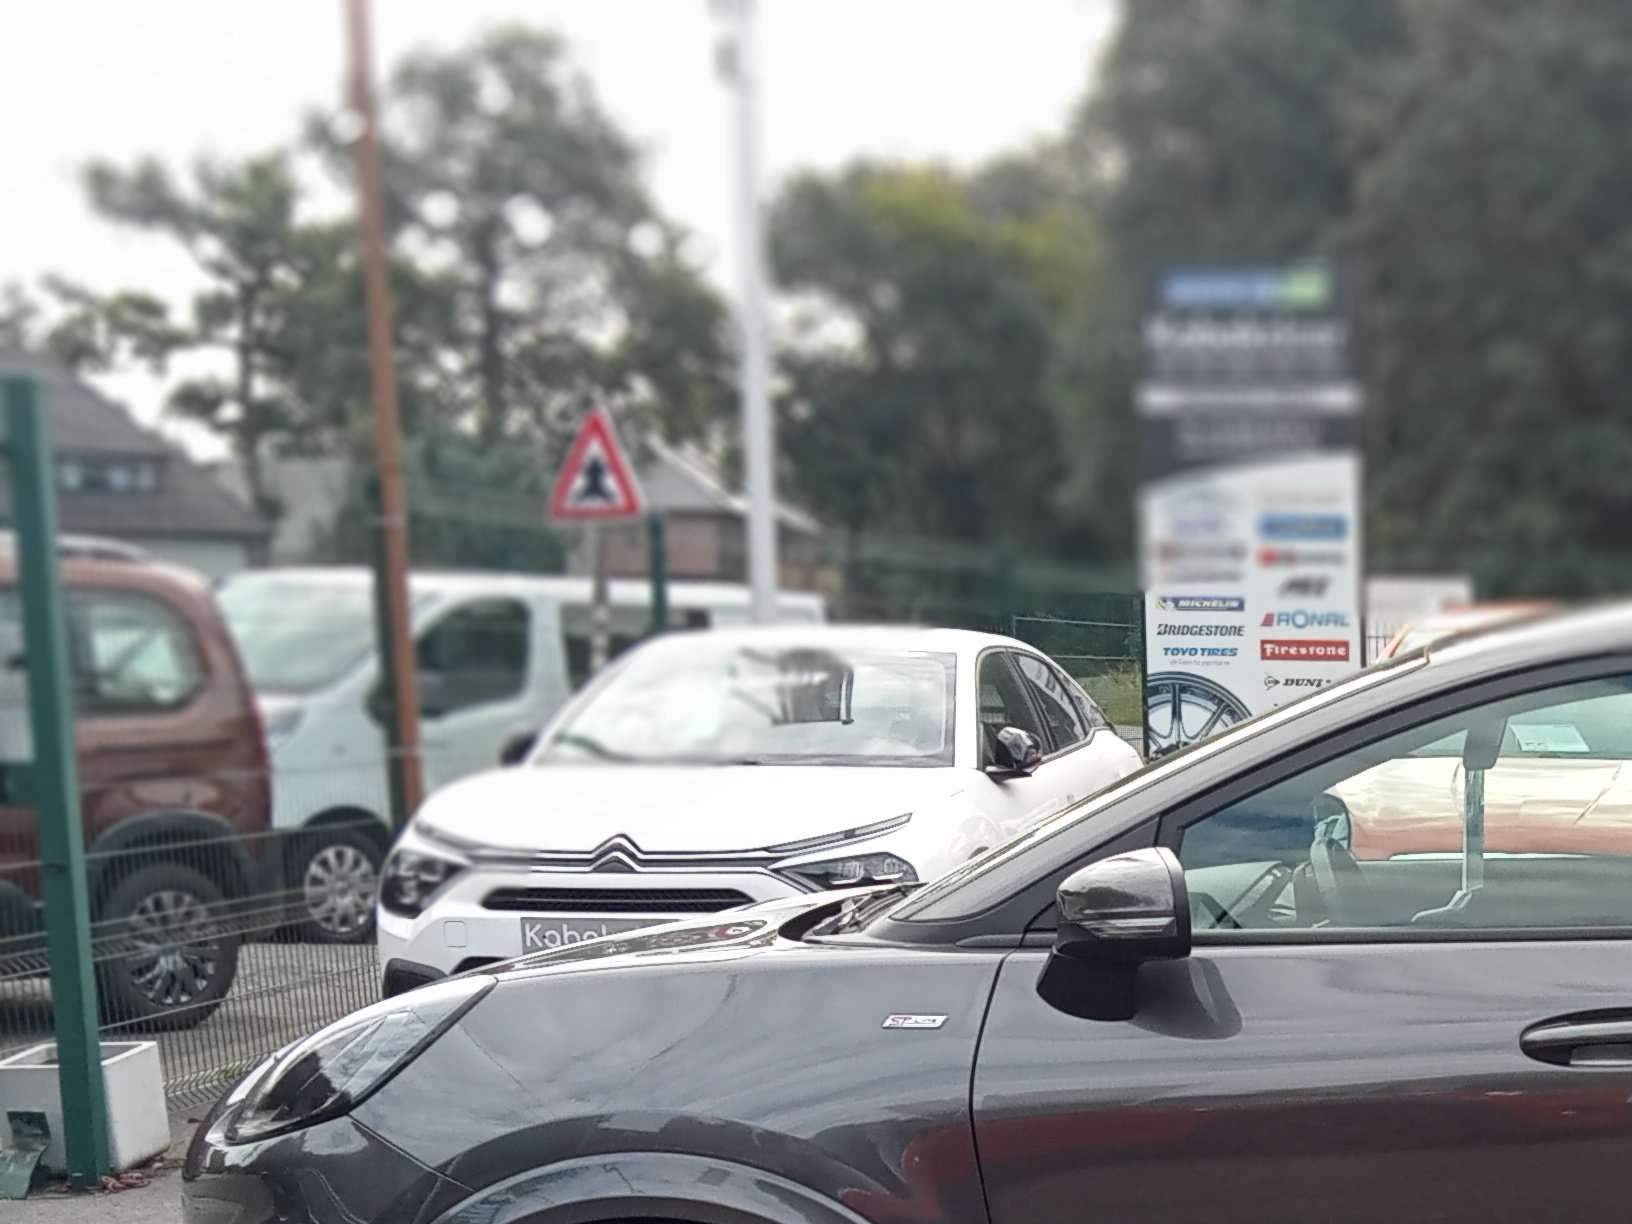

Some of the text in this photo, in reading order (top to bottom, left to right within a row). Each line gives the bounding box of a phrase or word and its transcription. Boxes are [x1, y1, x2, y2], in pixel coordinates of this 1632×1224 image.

[1156, 623, 1245, 637] BRIDGESTONE
[1163, 647, 1239, 656] TOYO TIRES
[1262, 643, 1347, 656] Firestone
